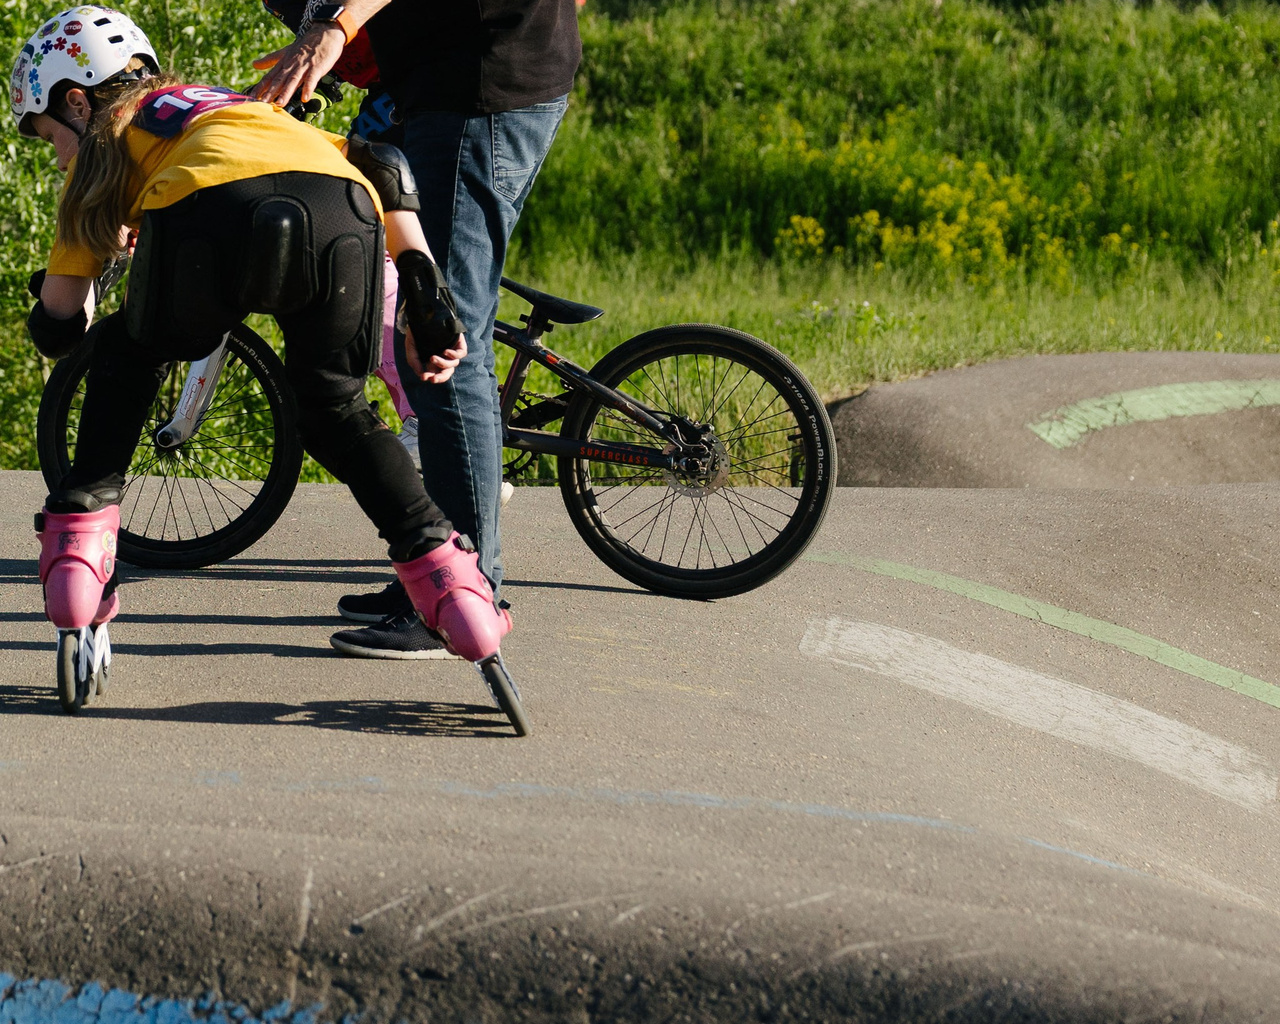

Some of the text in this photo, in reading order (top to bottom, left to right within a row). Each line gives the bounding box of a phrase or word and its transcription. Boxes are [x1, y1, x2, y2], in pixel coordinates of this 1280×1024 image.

[153, 87, 229, 111] 16
[791, 384, 810, 412] TIOGA
[580, 446, 649, 466] SUPERCLASS
